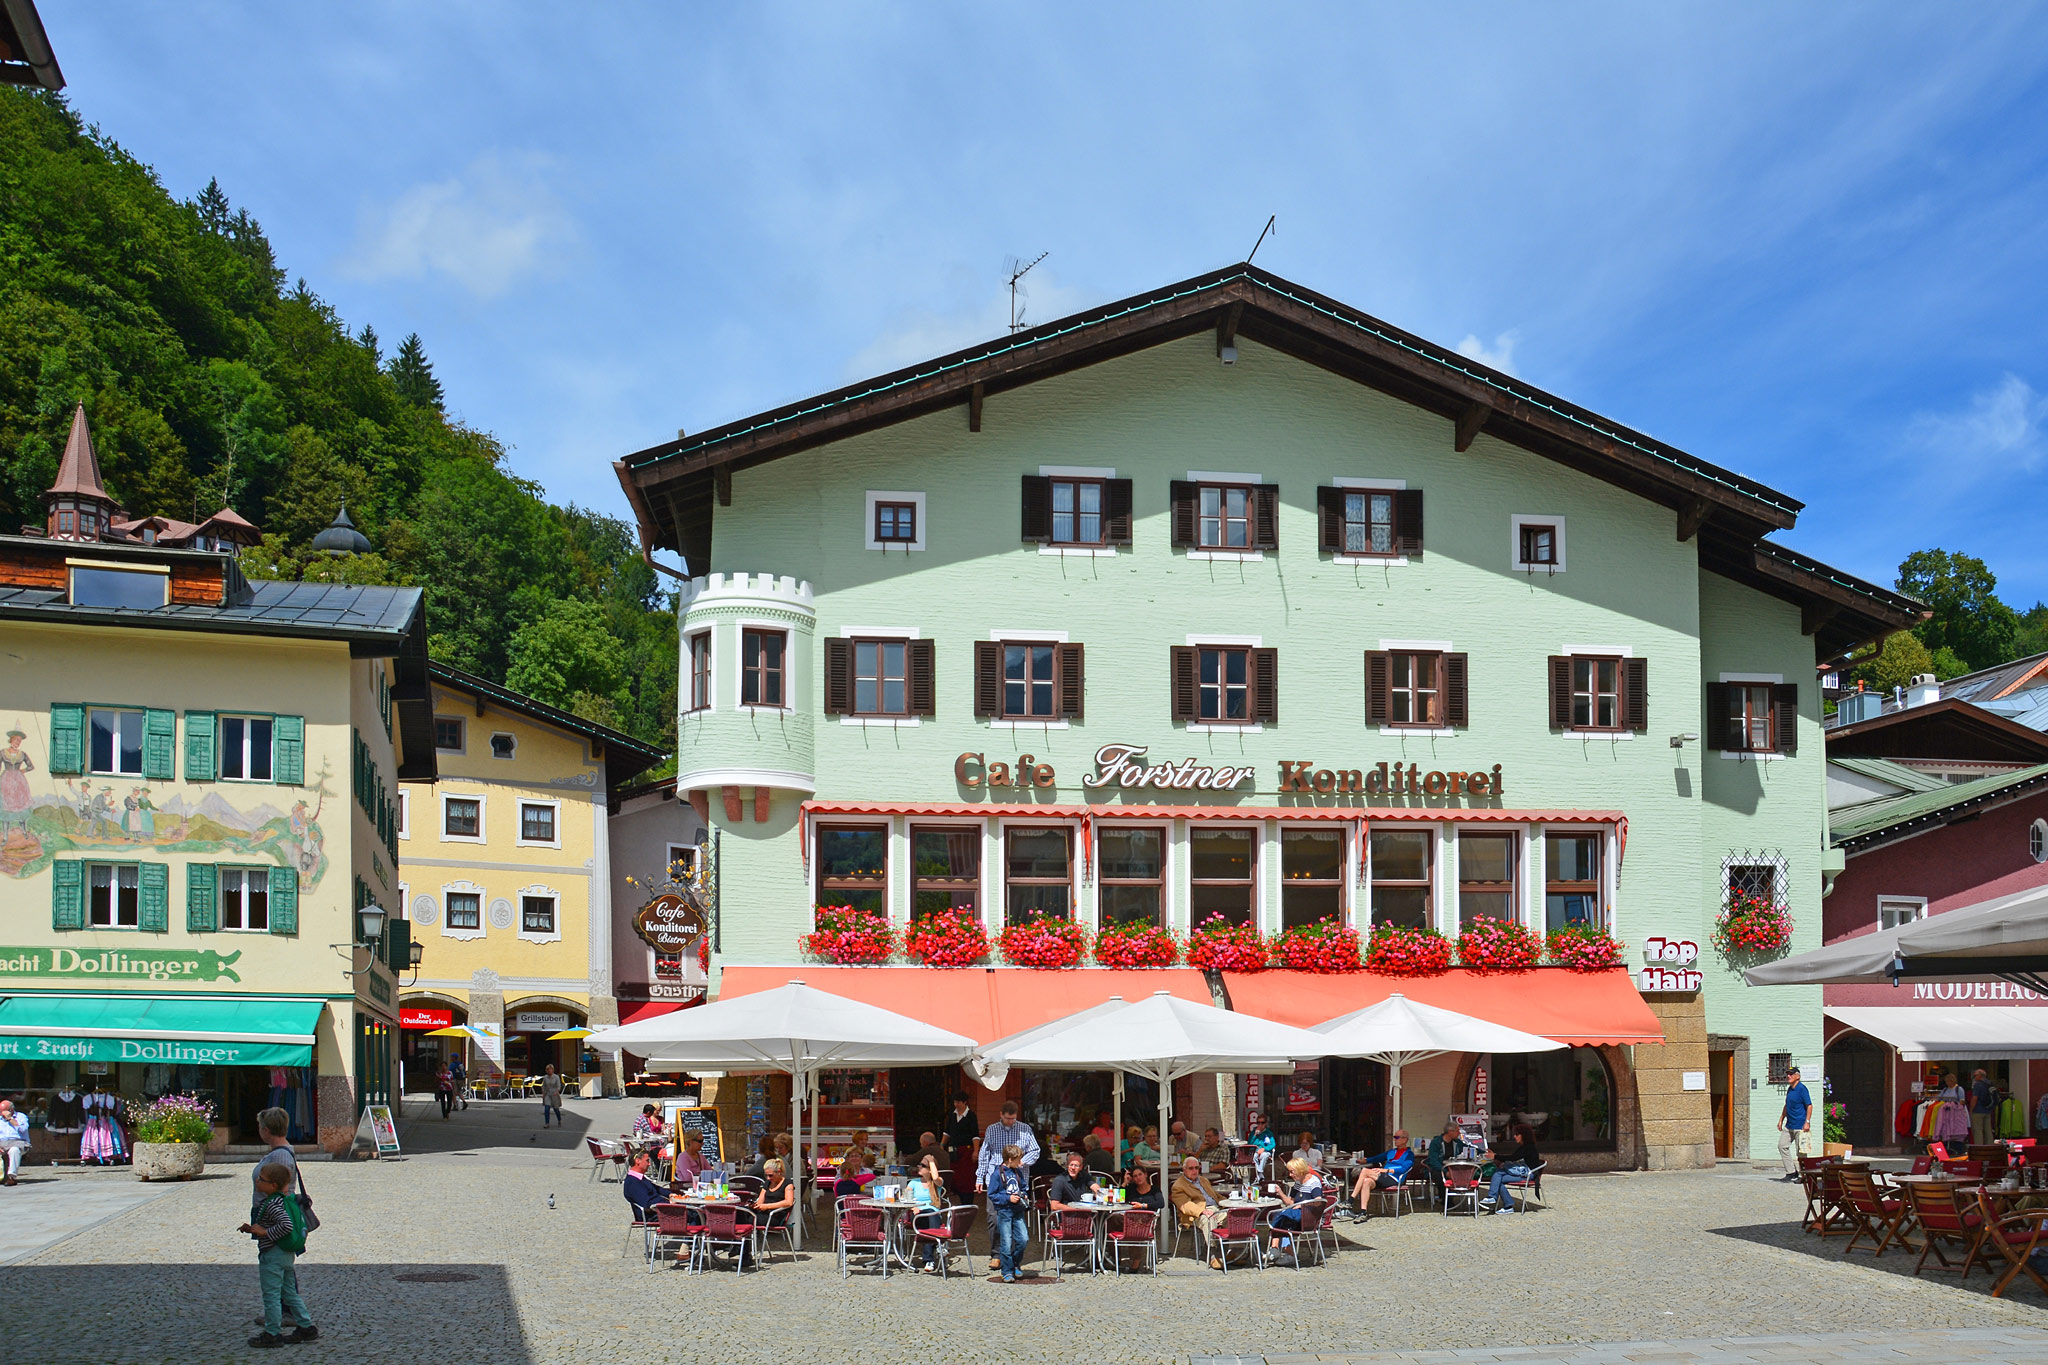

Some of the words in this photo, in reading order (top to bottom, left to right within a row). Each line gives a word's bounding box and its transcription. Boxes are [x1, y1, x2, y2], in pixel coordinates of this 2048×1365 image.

[955, 752, 1056, 788] Cafe
[1083, 743, 1256, 791] Forstner
[1278, 760, 1504, 795] Konditorei
[656, 901, 686, 922] Cafe
[645, 921, 698, 934] Konditorei
[657, 932, 687, 944] Bistro
[1646, 936, 1699, 965] Top
[49, 948, 199, 981] Dollinger
[1641, 967, 1703, 991] Hair
[1913, 982, 2048, 1000] MODEHAU
[403, 1017, 448, 1025] OutdoorLaden
[521, 1014, 565, 1022] Grillstüberl
[36, 1039, 94, 1059] Tracht
[119, 1040, 240, 1065] Dollinger
[1474, 1066, 1487, 1106] Hair
